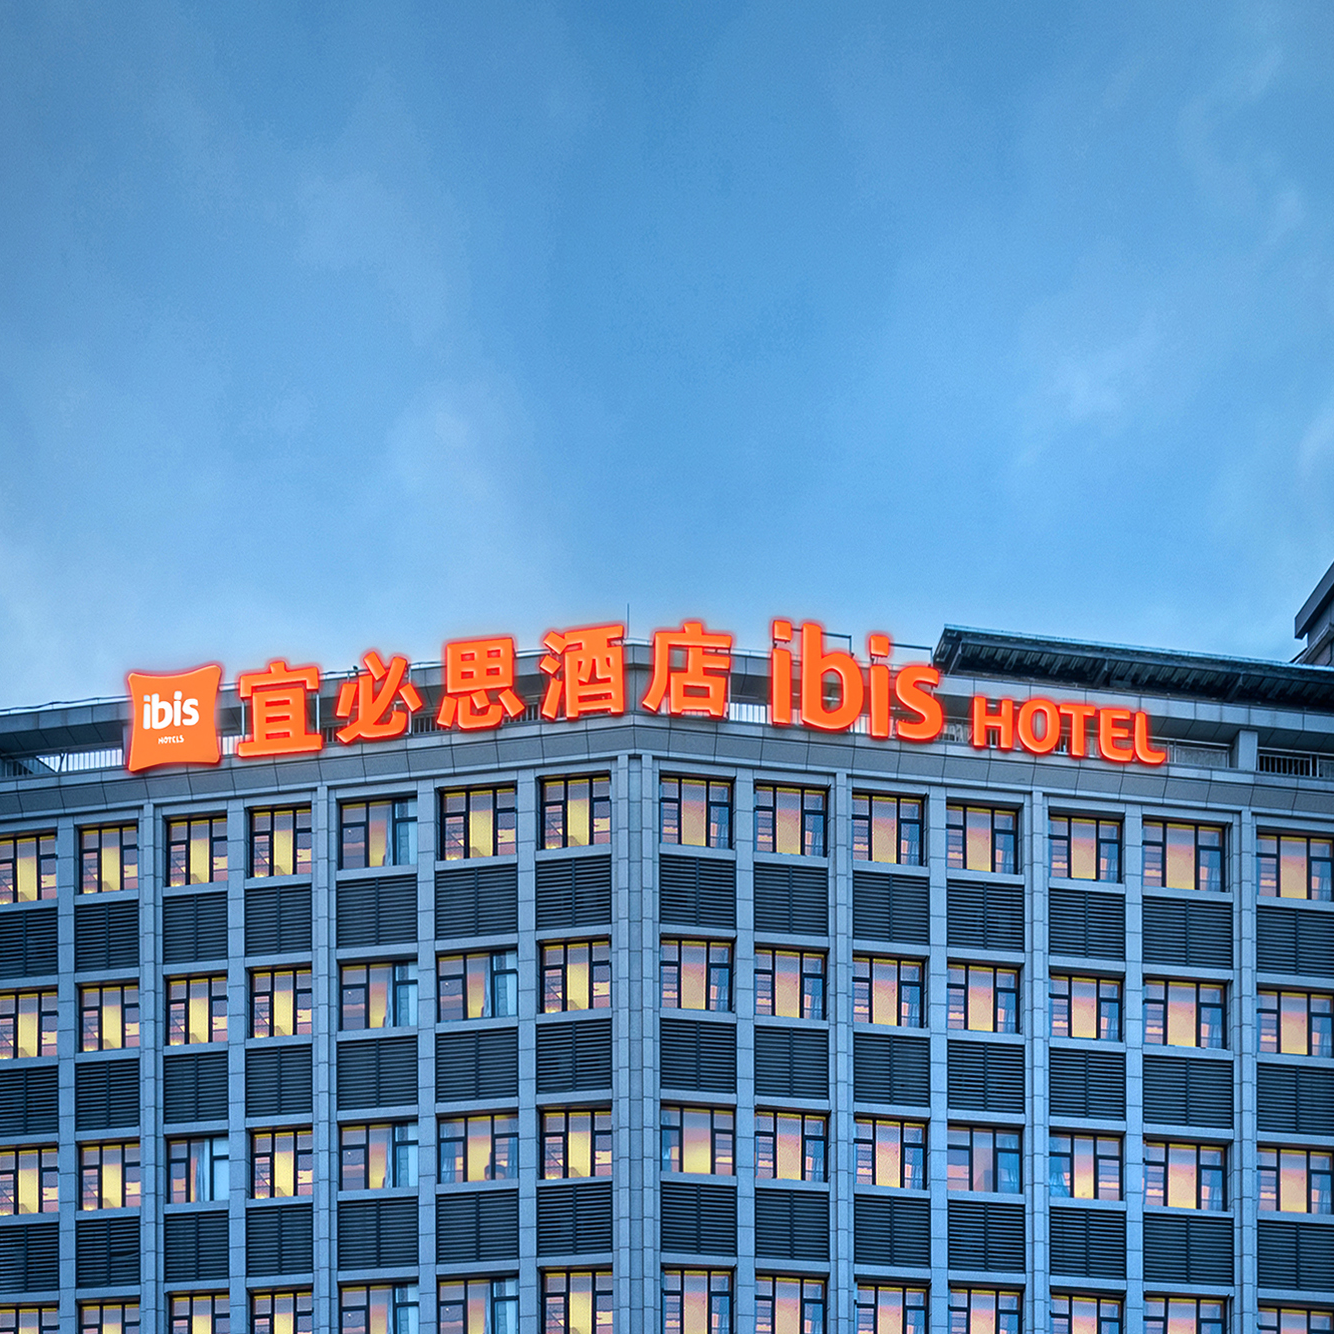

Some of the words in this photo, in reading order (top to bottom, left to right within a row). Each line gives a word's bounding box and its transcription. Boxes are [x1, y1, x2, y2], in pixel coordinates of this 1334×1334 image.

[143, 690, 199, 730] ibis
[238, 622, 732, 758] 宜必思酒店
[772, 620, 943, 741] ibis
[973, 696, 1166, 764] HOTEL
[158, 734, 185, 745] HOTELS
